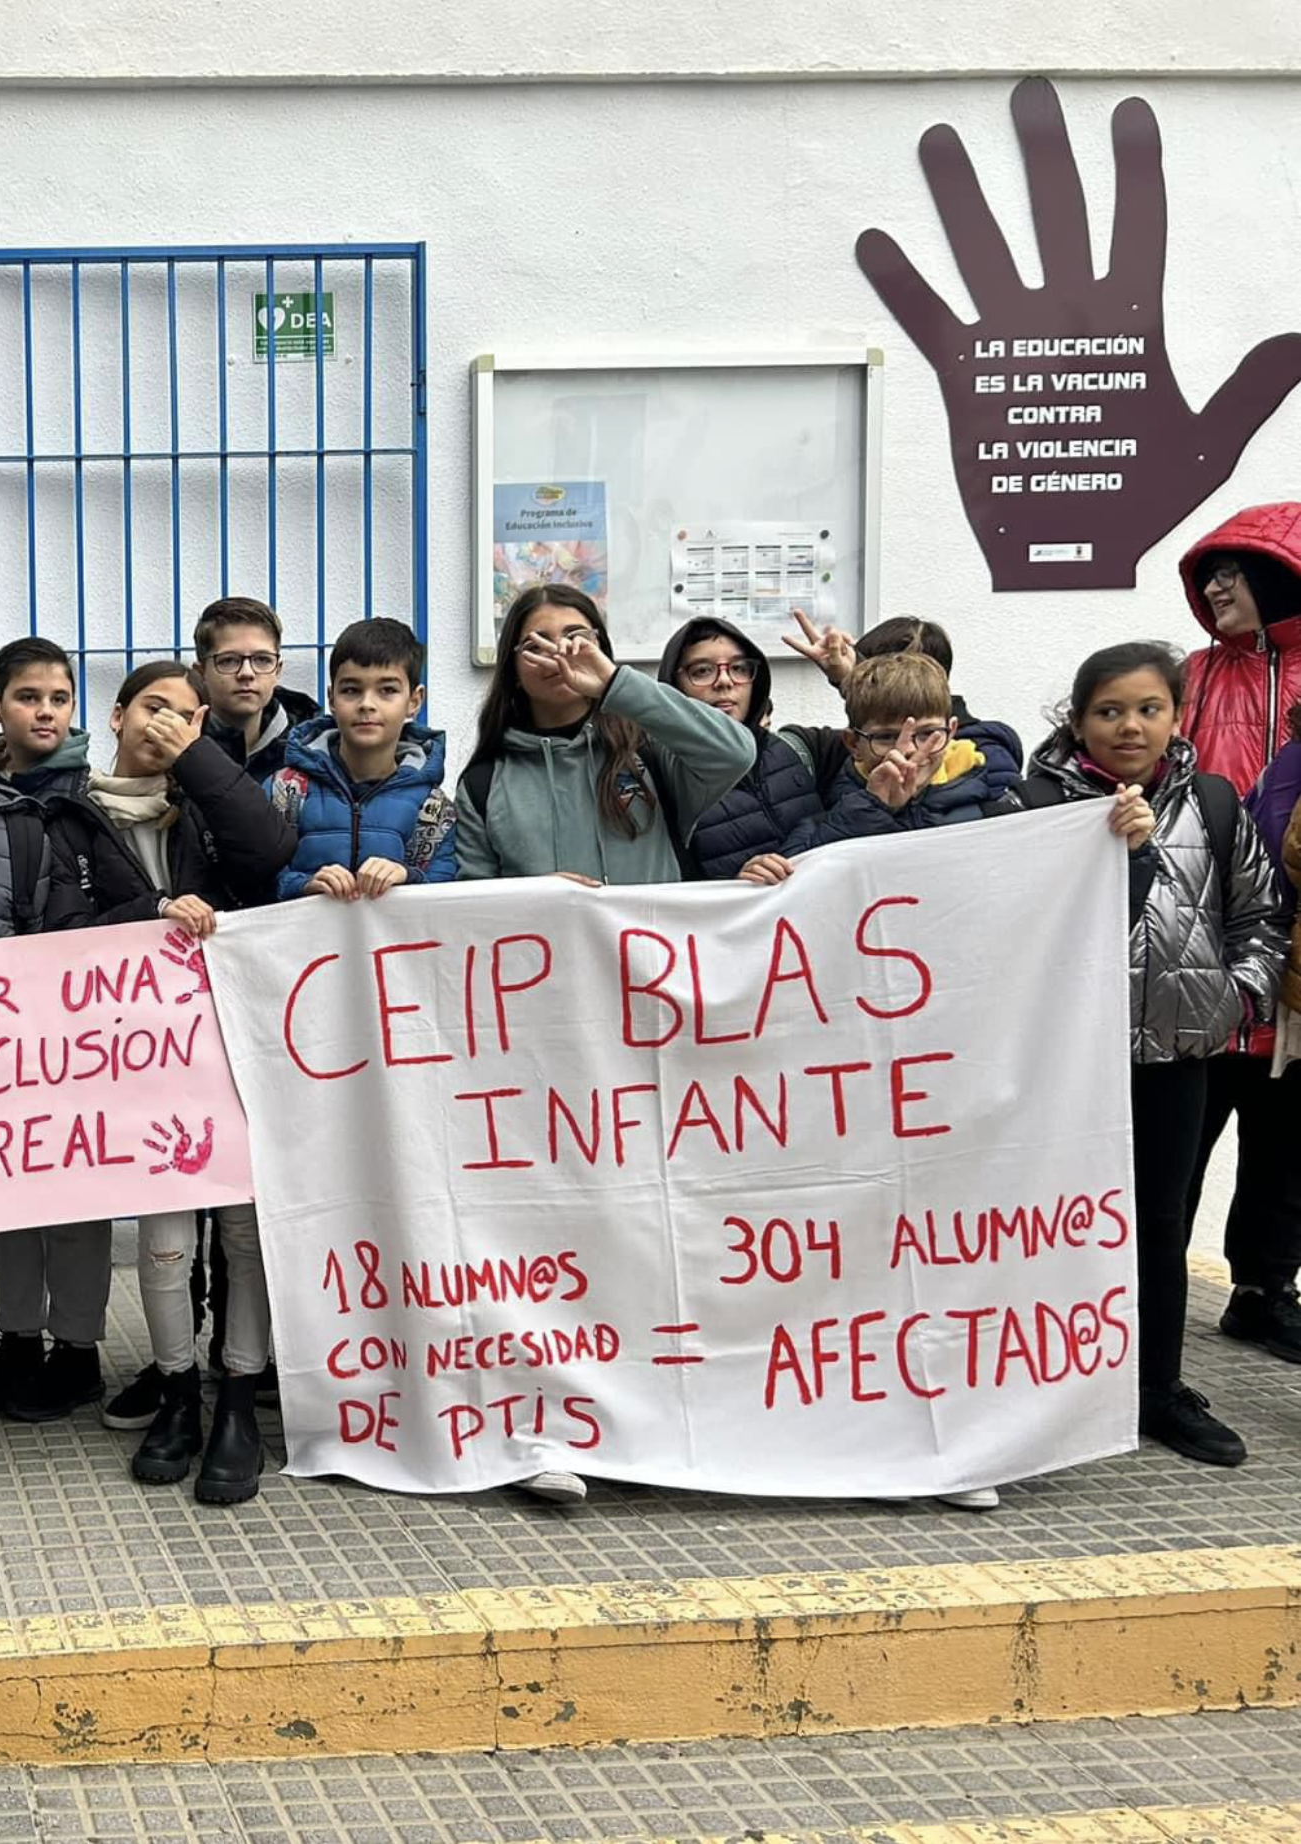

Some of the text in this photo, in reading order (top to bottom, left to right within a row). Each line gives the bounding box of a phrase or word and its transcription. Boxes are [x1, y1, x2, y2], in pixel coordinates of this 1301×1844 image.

[291, 313, 332, 329] DEA
[975, 334, 1145, 358] LA EDUCACIÓN
[975, 372, 1147, 394] ES LA VACUNA
[1008, 405, 1102, 424] CONTRA
[978, 439, 1137, 460] LA VIOLENCIA
[992, 470, 1123, 494] DE GÉNERO
[505, 519, 551, 531] Educación
[520, 507, 577, 519] Programa de
[61, 955, 163, 1013] UNA
[283, 895, 932, 1080] CEIP BLAS
[455, 1052, 955, 1169] INFANTE
[323, 1187, 1128, 1314] 18 ALUMN@S 304 ALUMN@S
[327, 1337, 407, 1380] CON
[427, 1325, 620, 1376] NECESIDAD
[764, 1285, 1128, 1410] AFECTAD@S
[339, 1391, 400, 1453] DE
